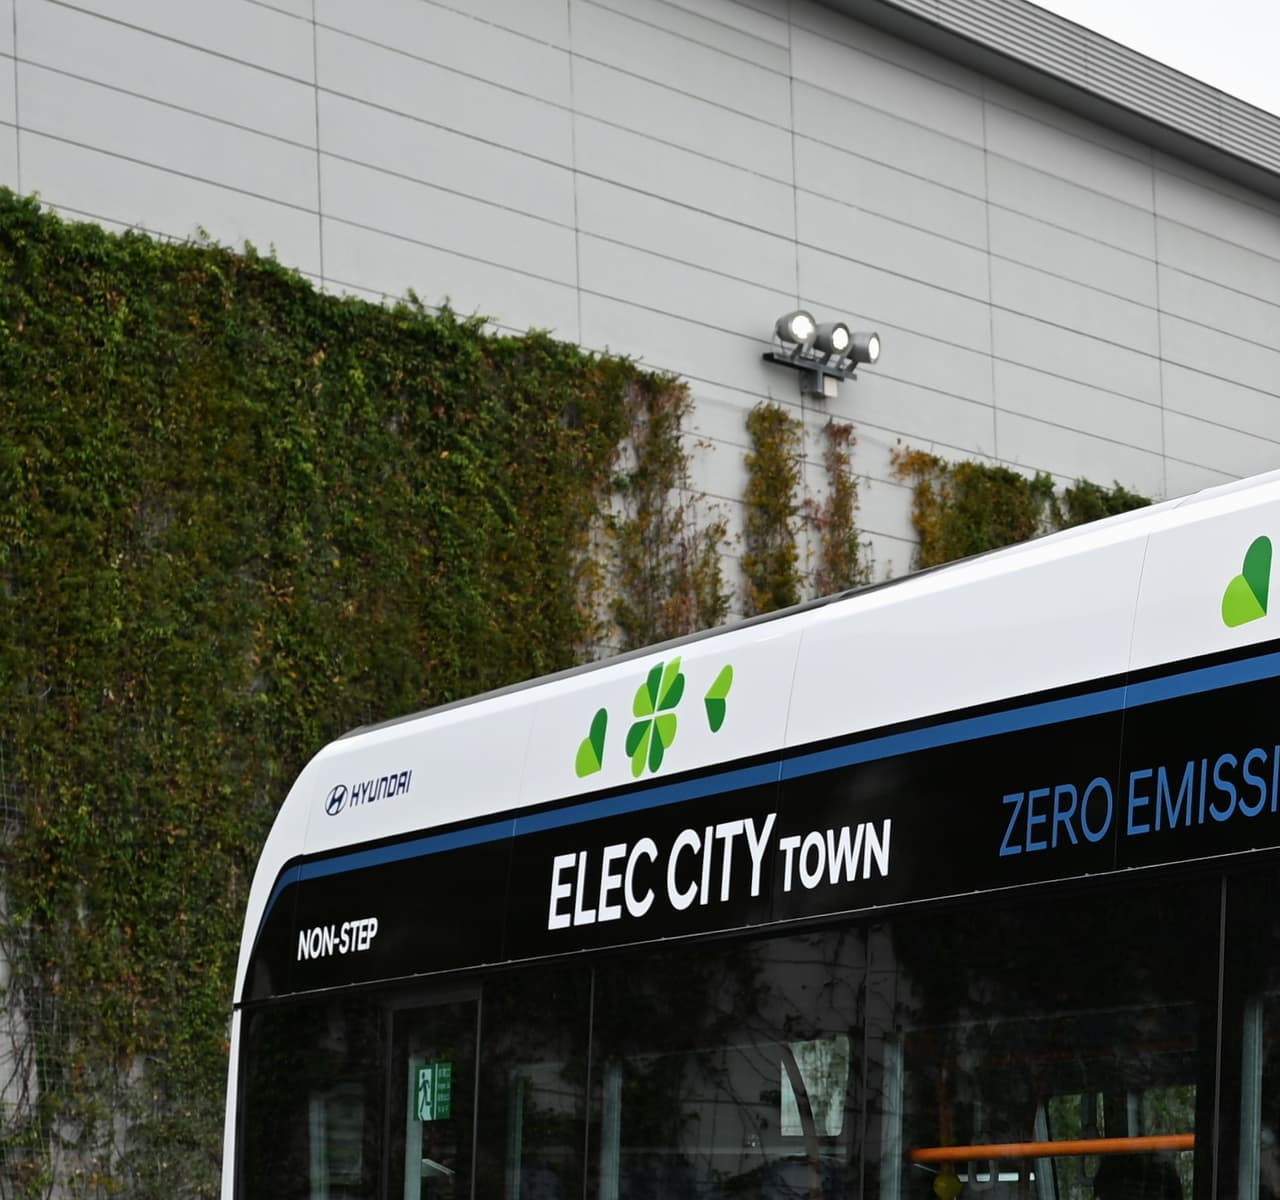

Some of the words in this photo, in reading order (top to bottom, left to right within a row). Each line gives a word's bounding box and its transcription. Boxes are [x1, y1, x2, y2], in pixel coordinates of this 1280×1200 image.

[350, 770, 412, 808] HYUNDAI
[1000, 777, 1113, 857] ZERO
[548, 838, 657, 930] ELEC
[667, 813, 777, 911] CITY
[780, 819, 892, 892] TOWN
[298, 918, 378, 961] NON-STEP
